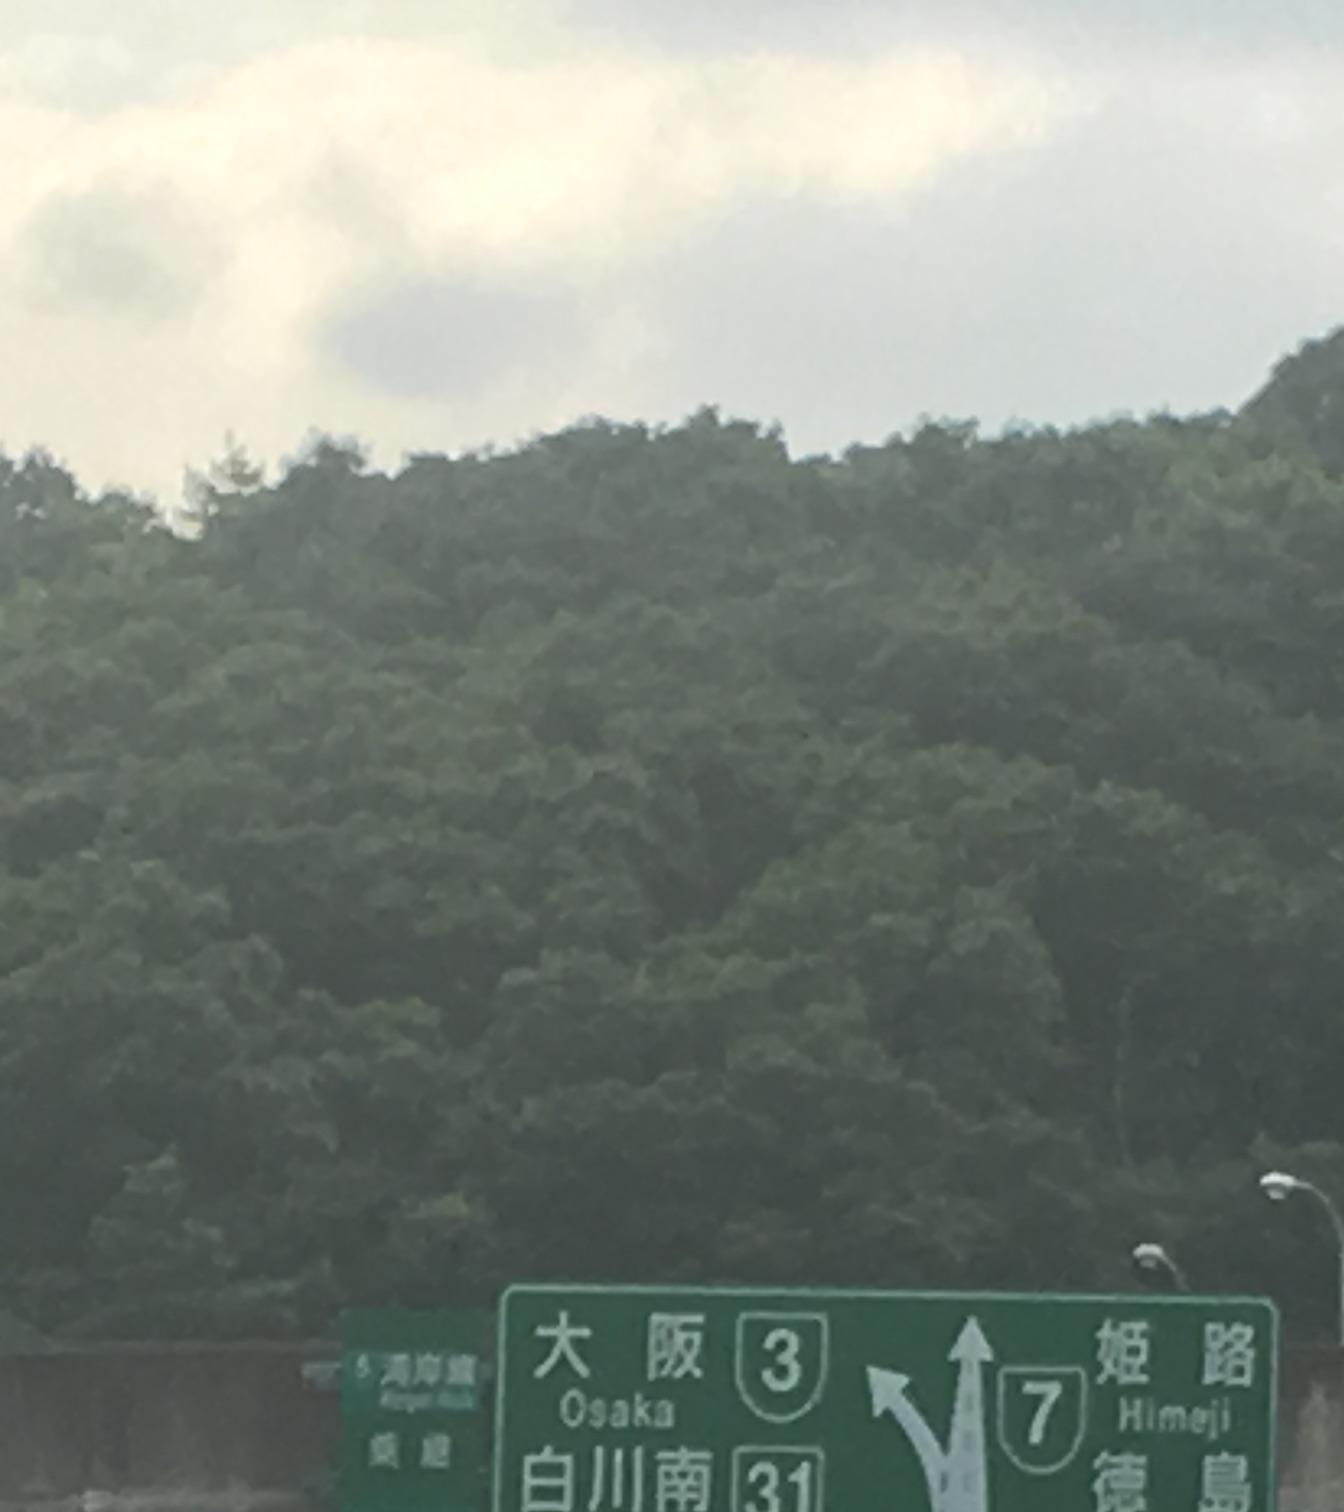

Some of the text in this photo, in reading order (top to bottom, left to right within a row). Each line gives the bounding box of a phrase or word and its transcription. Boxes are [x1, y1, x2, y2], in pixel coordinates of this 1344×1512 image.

[533, 1311, 706, 1382] 大阪
[760, 1328, 802, 1392] 3
[1094, 1318, 1255, 1388] 姫路
[558, 1388, 675, 1429] Osaka
[1021, 1380, 1063, 1445] 7
[1118, 1396, 1232, 1441] Himeji
